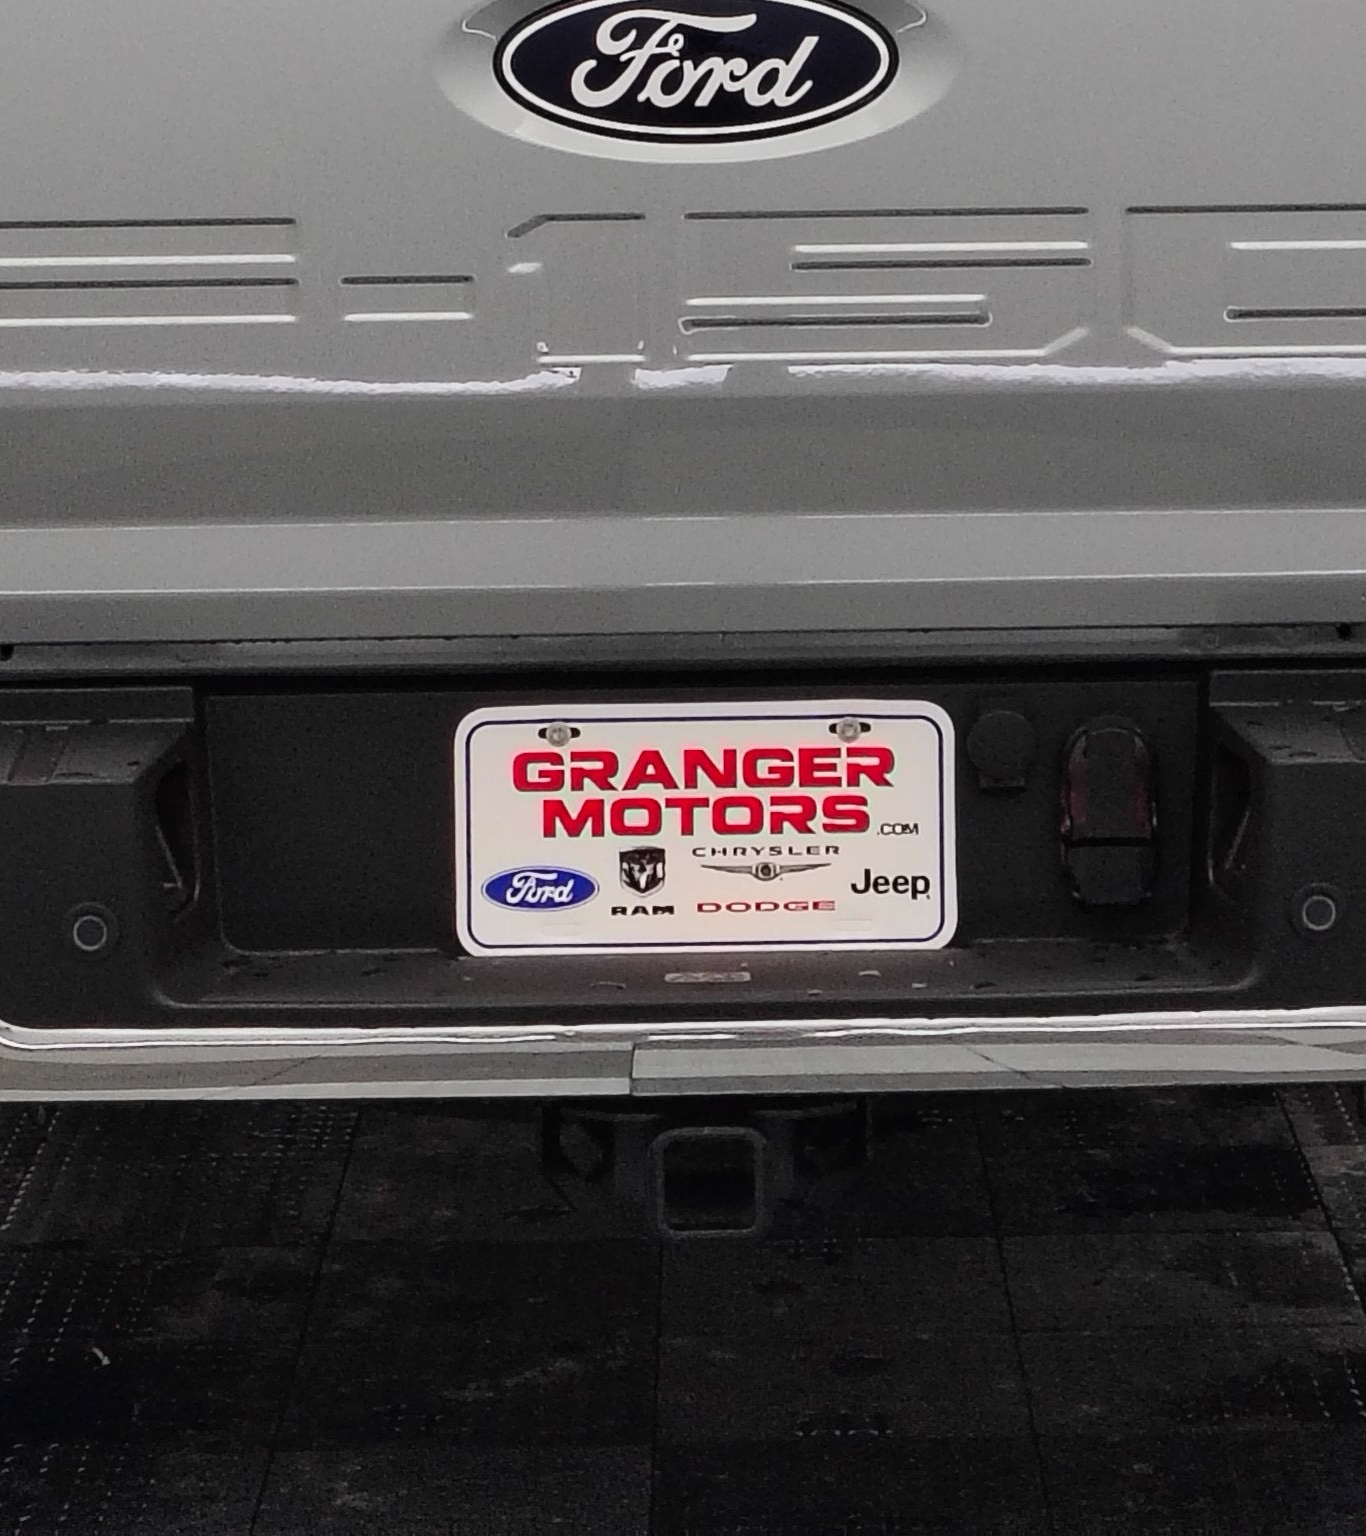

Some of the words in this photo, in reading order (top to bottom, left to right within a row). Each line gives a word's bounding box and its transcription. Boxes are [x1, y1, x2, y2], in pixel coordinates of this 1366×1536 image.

[571, 9, 819, 108] Ford
[512, 746, 895, 792] GRANGER
[543, 795, 870, 838] MOTORS
[692, 846, 840, 857] CHRYSLER
[506, 871, 575, 904] Ford
[850, 868, 931, 900] Jeep
[611, 905, 675, 915] RAM
[697, 901, 835, 912] DODGE
